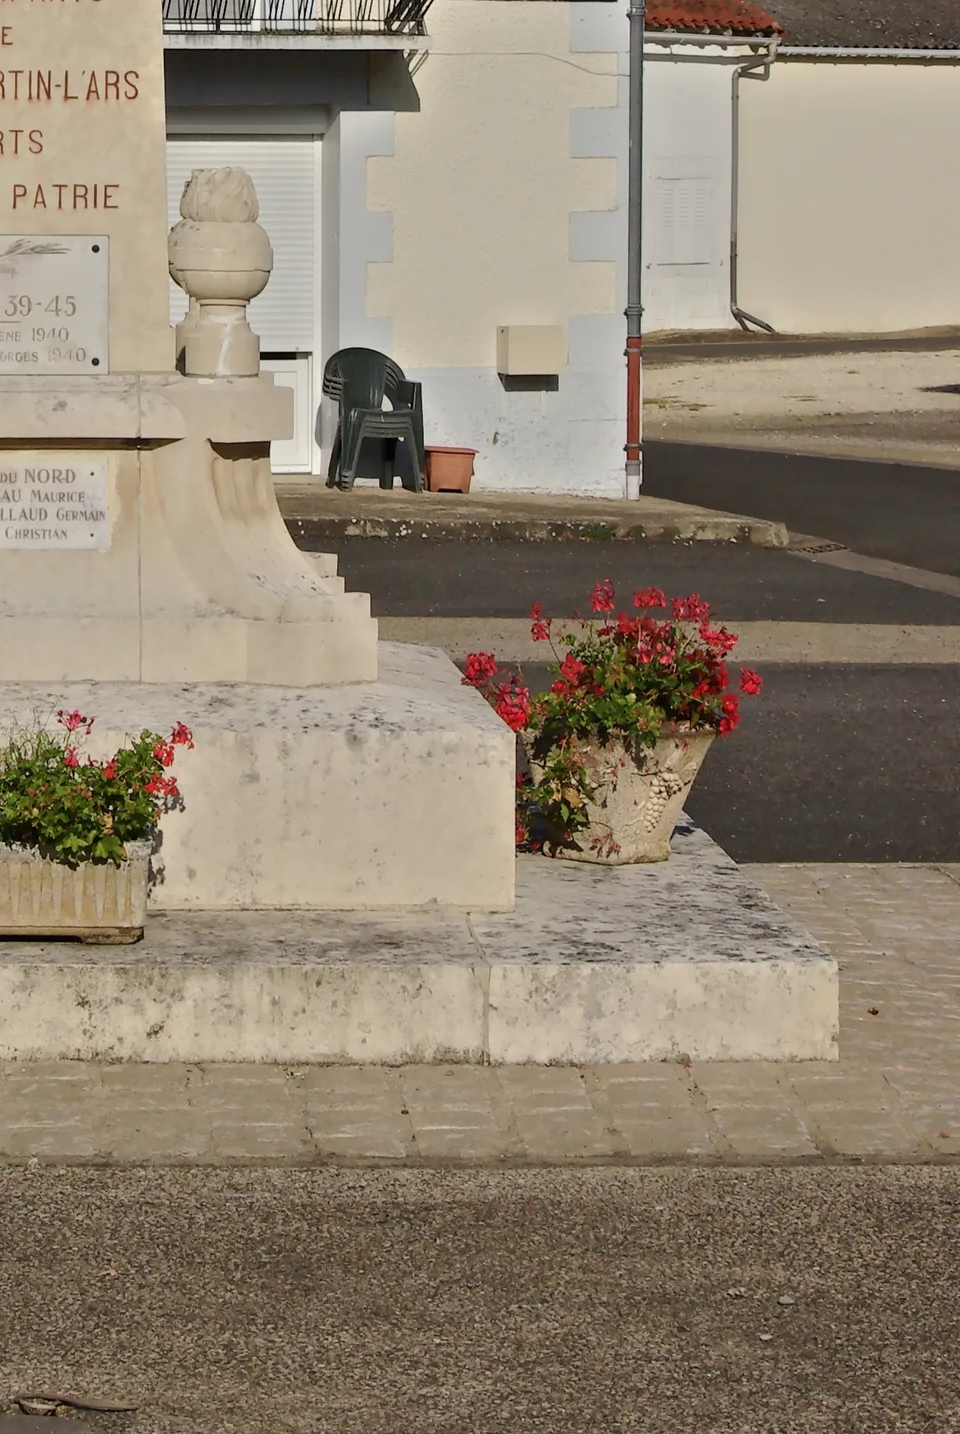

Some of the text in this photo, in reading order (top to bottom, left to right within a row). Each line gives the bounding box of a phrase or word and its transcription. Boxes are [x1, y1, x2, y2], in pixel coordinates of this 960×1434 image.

[13, 183, 119, 209] PATRIE
[5, 295, 77, 316] 39-45
[32, 328, 69, 341] 1940
[48, 348, 86, 362] 1940
[24, 469, 76, 483] NORD
